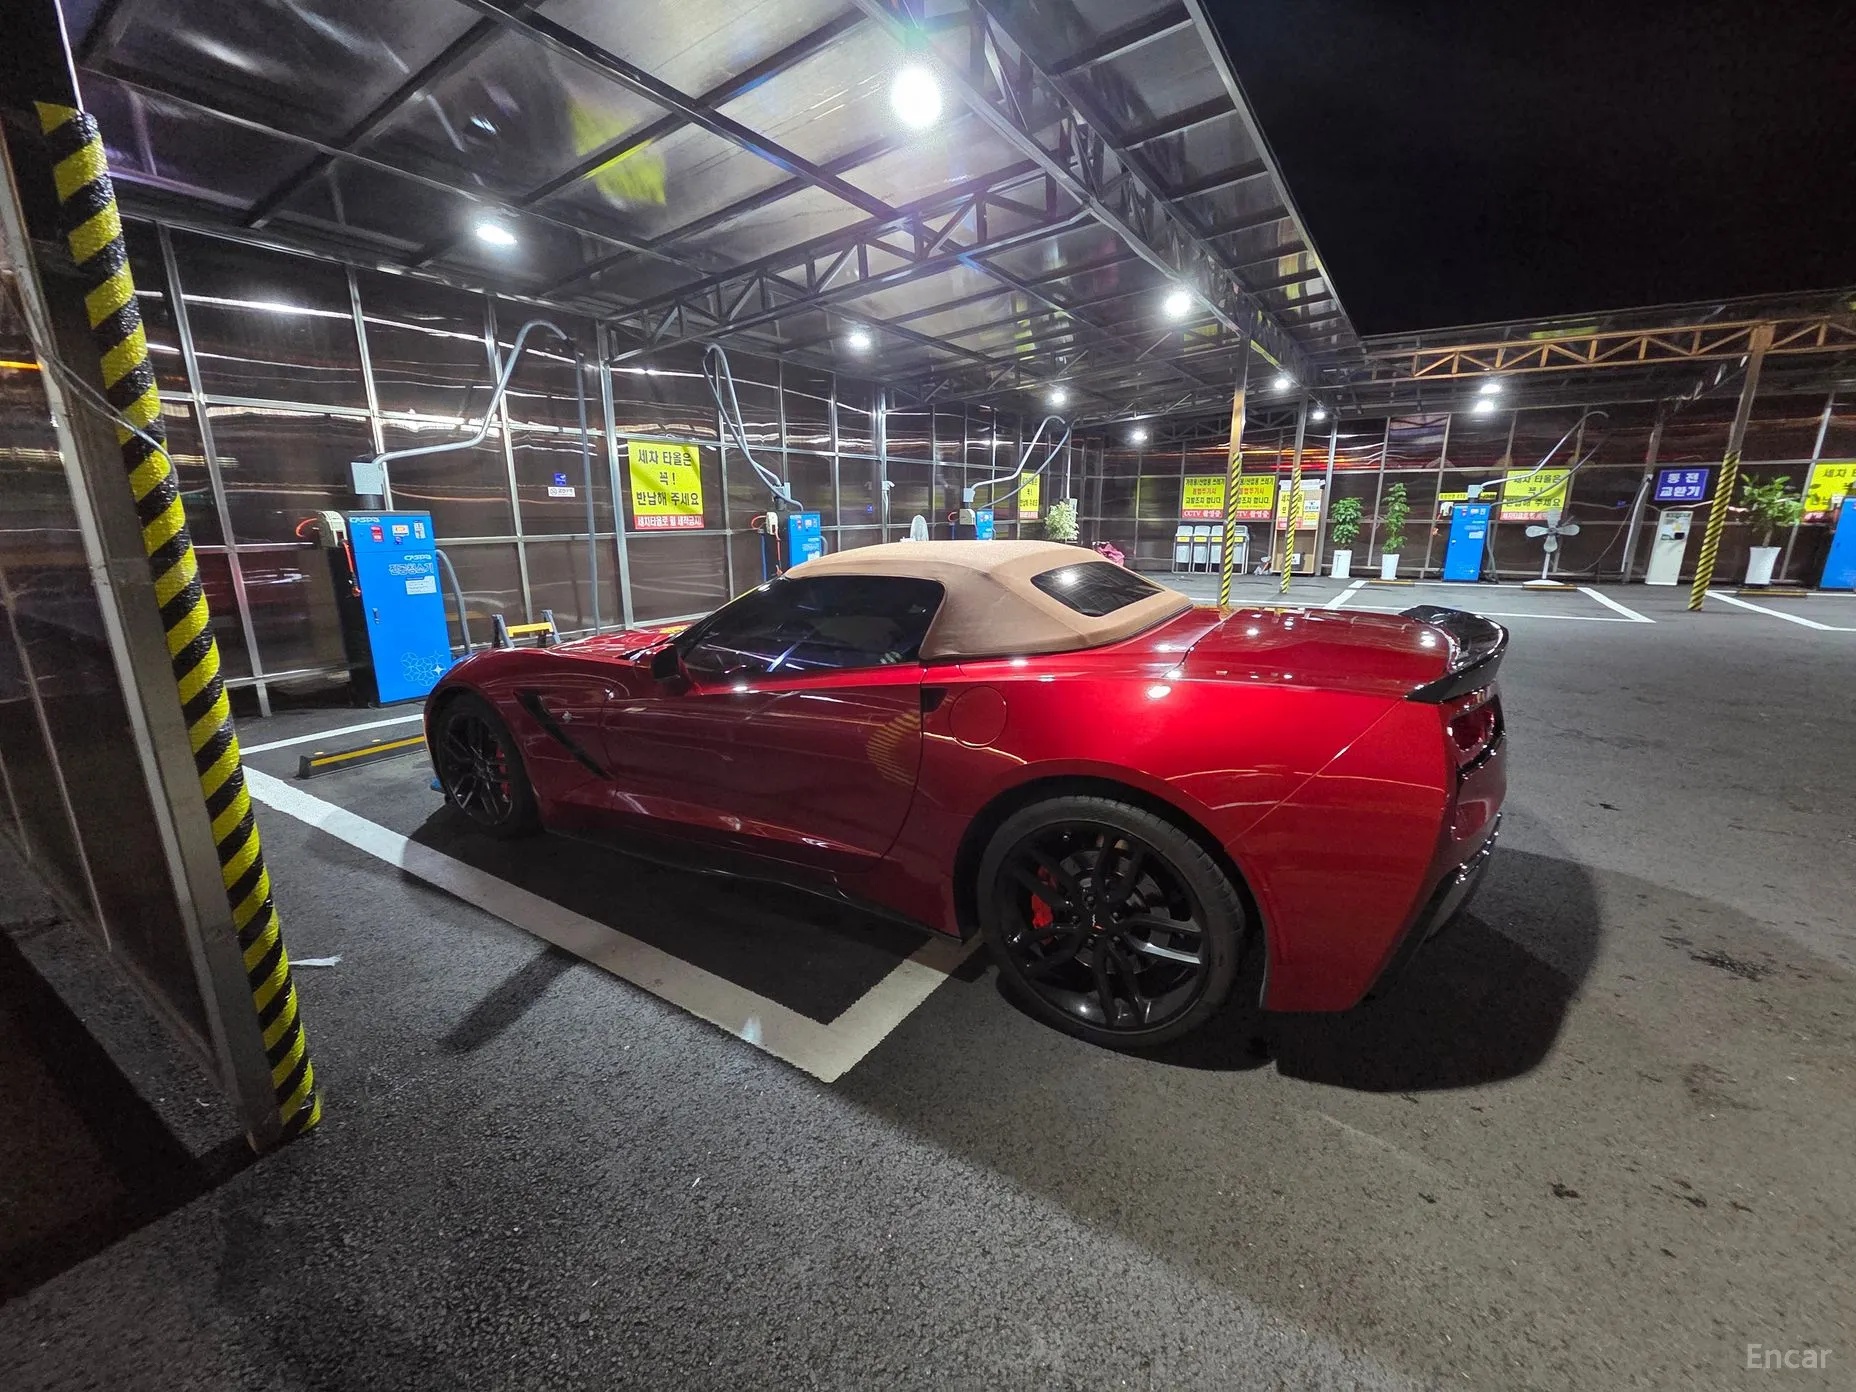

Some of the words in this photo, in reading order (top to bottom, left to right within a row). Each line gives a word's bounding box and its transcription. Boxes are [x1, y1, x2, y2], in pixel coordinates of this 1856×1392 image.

[638, 449, 659, 464] 세차
[662, 451, 692, 467] 타올은
[636, 491, 667, 506] 반납해
[671, 492, 699, 506] 주세요
[1659, 485, 1701, 497] 교환기
